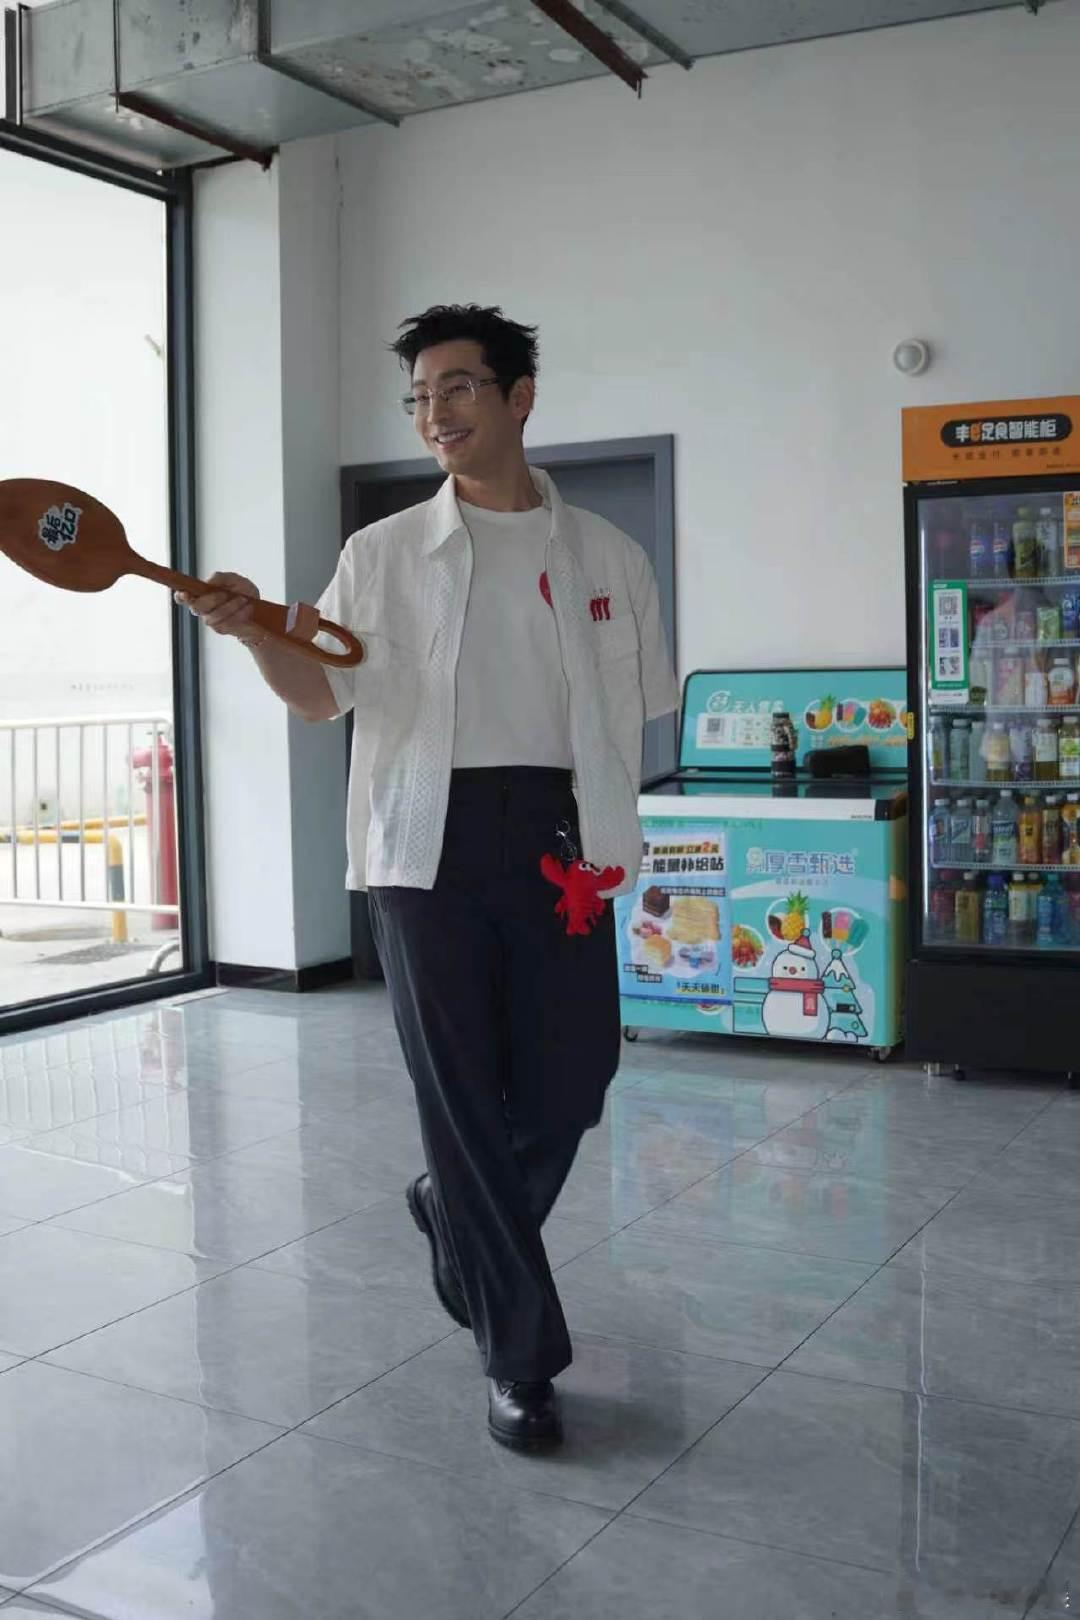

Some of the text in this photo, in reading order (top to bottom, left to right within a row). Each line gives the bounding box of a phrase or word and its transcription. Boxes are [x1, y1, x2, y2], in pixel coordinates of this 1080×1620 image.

[652, 856, 725, 874] 能量补给站
